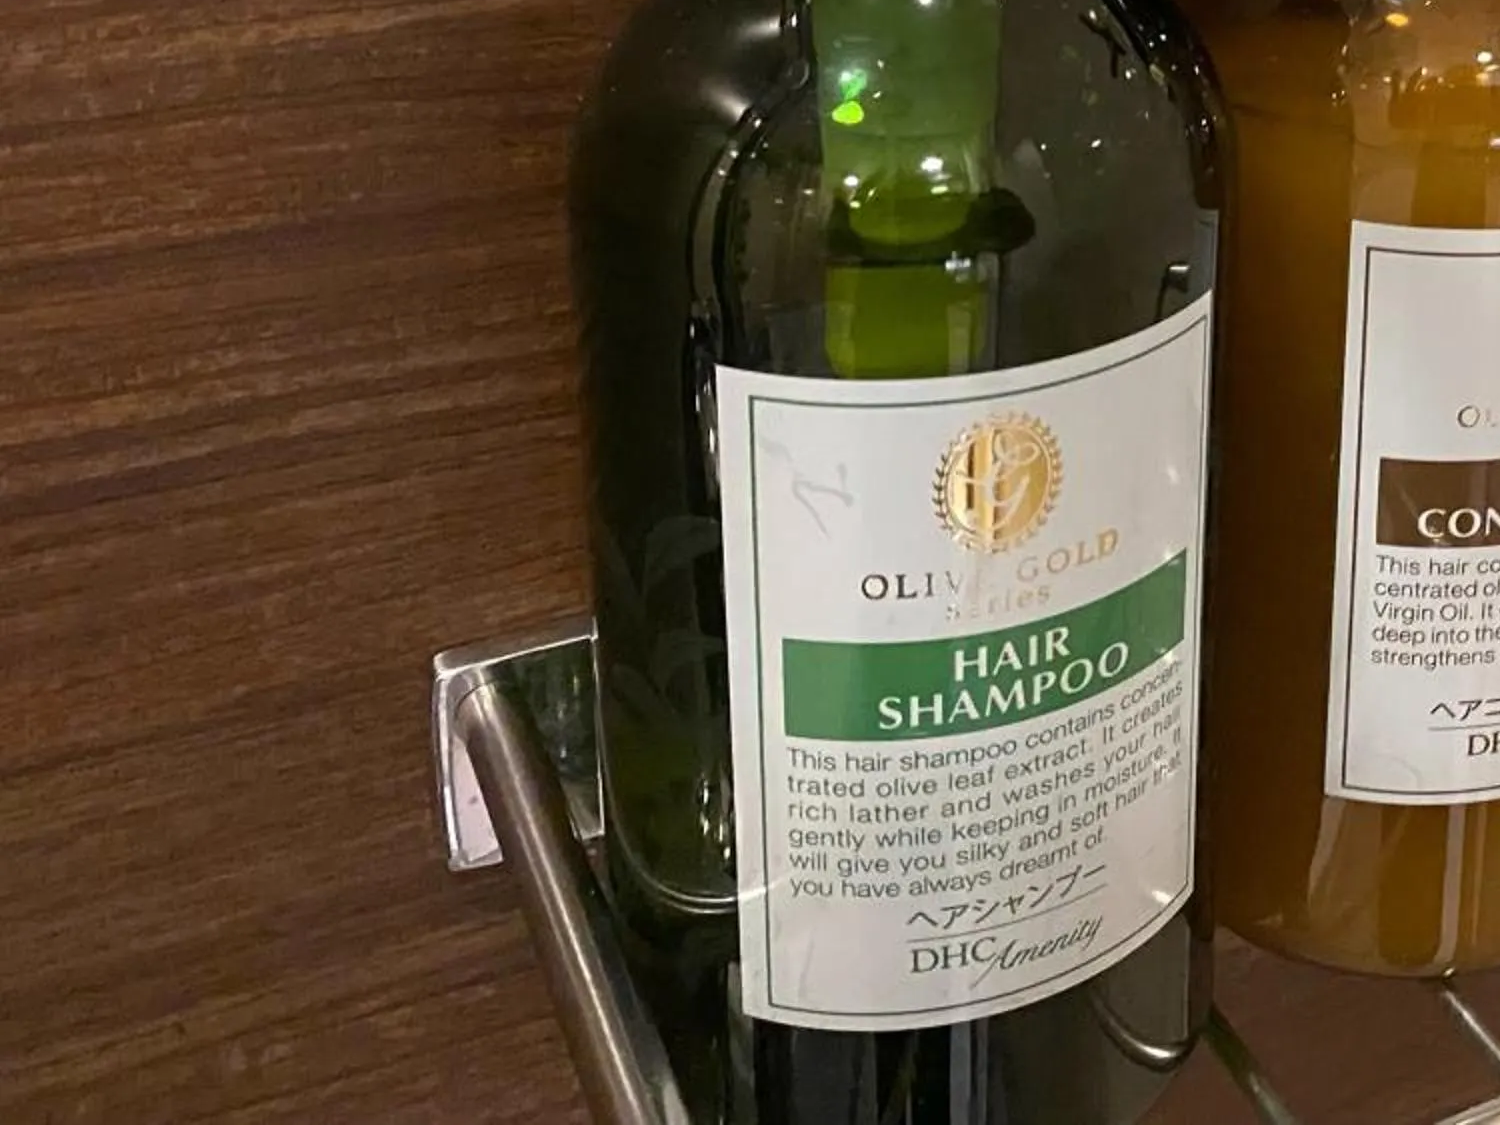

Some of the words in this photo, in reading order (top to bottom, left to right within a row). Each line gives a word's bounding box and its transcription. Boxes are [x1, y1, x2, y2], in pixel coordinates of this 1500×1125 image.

[860, 570, 986, 602] OLIV
[1016, 527, 1120, 583] GOLD
[1373, 578, 1478, 600] centrated
[1376, 554, 1421, 577] This
[1429, 556, 1471, 577] hair
[1371, 624, 1426, 649] deep
[1431, 626, 1470, 646] into
[1372, 600, 1435, 626] Virgin
[1439, 602, 1475, 623] Oil.
[1481, 602, 1494, 620] It
[955, 625, 1072, 683] HAIR
[1370, 647, 1496, 673] strengthens
[879, 642, 1130, 730] SHAMPOO
[787, 746, 837, 772] This
[845, 751, 893, 773] hair
[898, 738, 1018, 772] shampoo
[1025, 703, 1116, 750] contains
[787, 775, 865, 799] trated
[875, 775, 938, 799] olive
[948, 764, 995, 792] leaf
[1102, 725, 1115, 746] It
[1121, 679, 1184, 735] creates
[787, 801, 838, 822] rich
[848, 802, 930, 825] lather
[940, 791, 992, 819] and
[1001, 761, 1096, 807] washes
[1103, 732, 1148, 773] your
[788, 827, 866, 852] gently
[874, 826, 943, 849] while
[951, 804, 1050, 843] keeping
[1057, 792, 1077, 814] in
[788, 850, 828, 872] will
[836, 853, 890, 878] give
[898, 854, 947, 877] you
[955, 839, 1011, 866] silky
[1018, 818, 1063, 852] and
[1069, 800, 1109, 833] soft
[1114, 778, 1150, 811] hair
[789, 875, 834, 899] you
[841, 877, 901, 899] have
[907, 869, 993, 896] always
[999, 838, 1079, 881] dreamt
[910, 936, 997, 974] DHC
[968, 915, 1104, 990] Amenity
